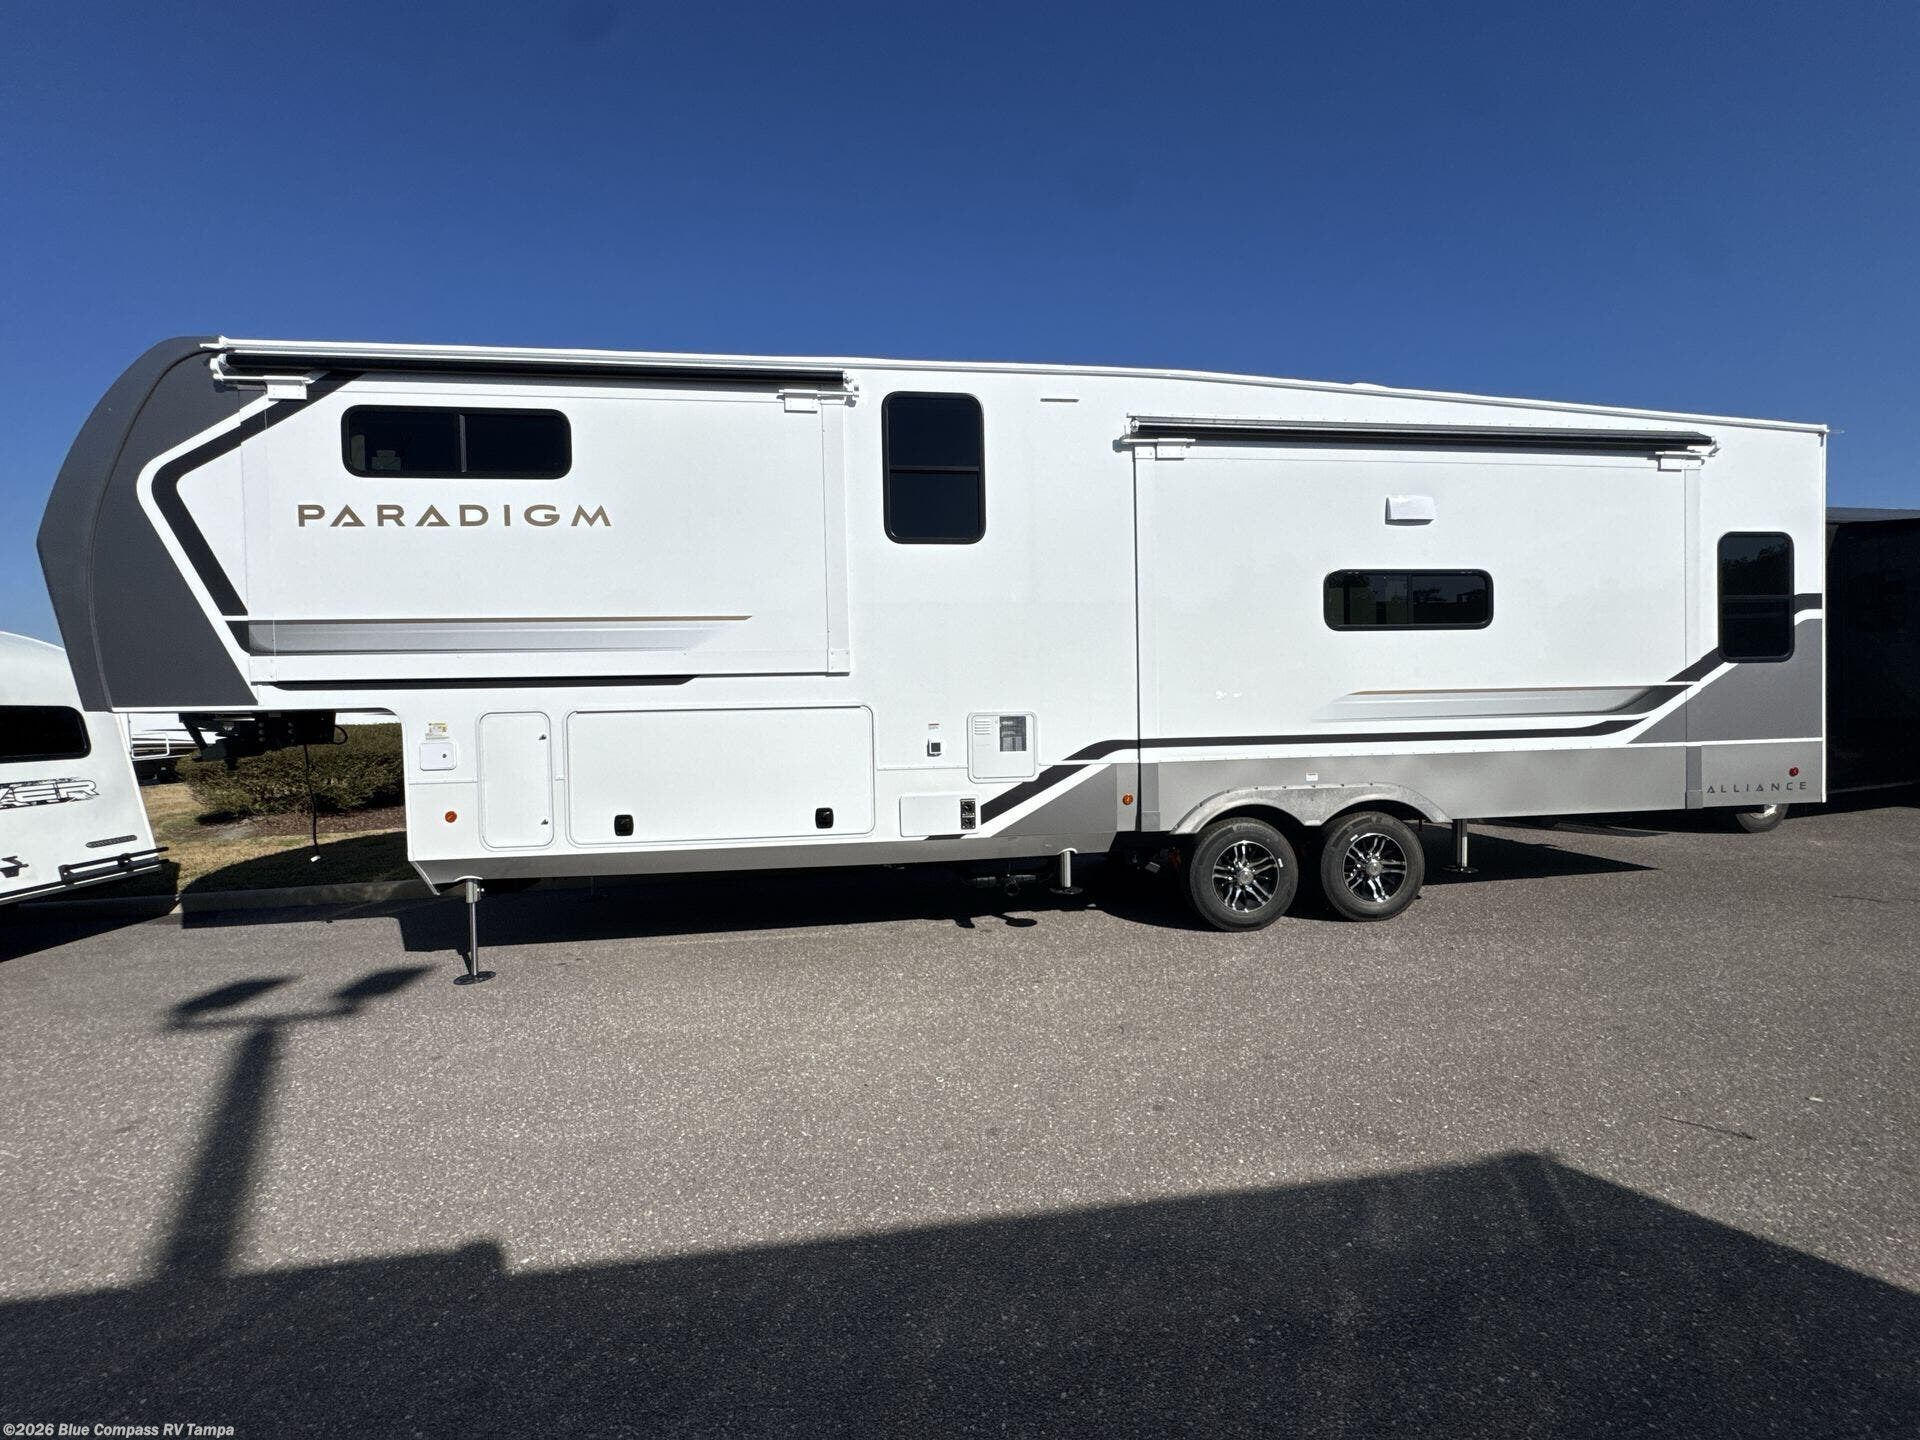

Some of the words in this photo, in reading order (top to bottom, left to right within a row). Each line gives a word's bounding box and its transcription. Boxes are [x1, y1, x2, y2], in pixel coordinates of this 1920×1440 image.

[297, 504, 612, 527] PARADIGM
[0, 778, 100, 807] ER
[1706, 781, 1808, 794] ALLIANCE
